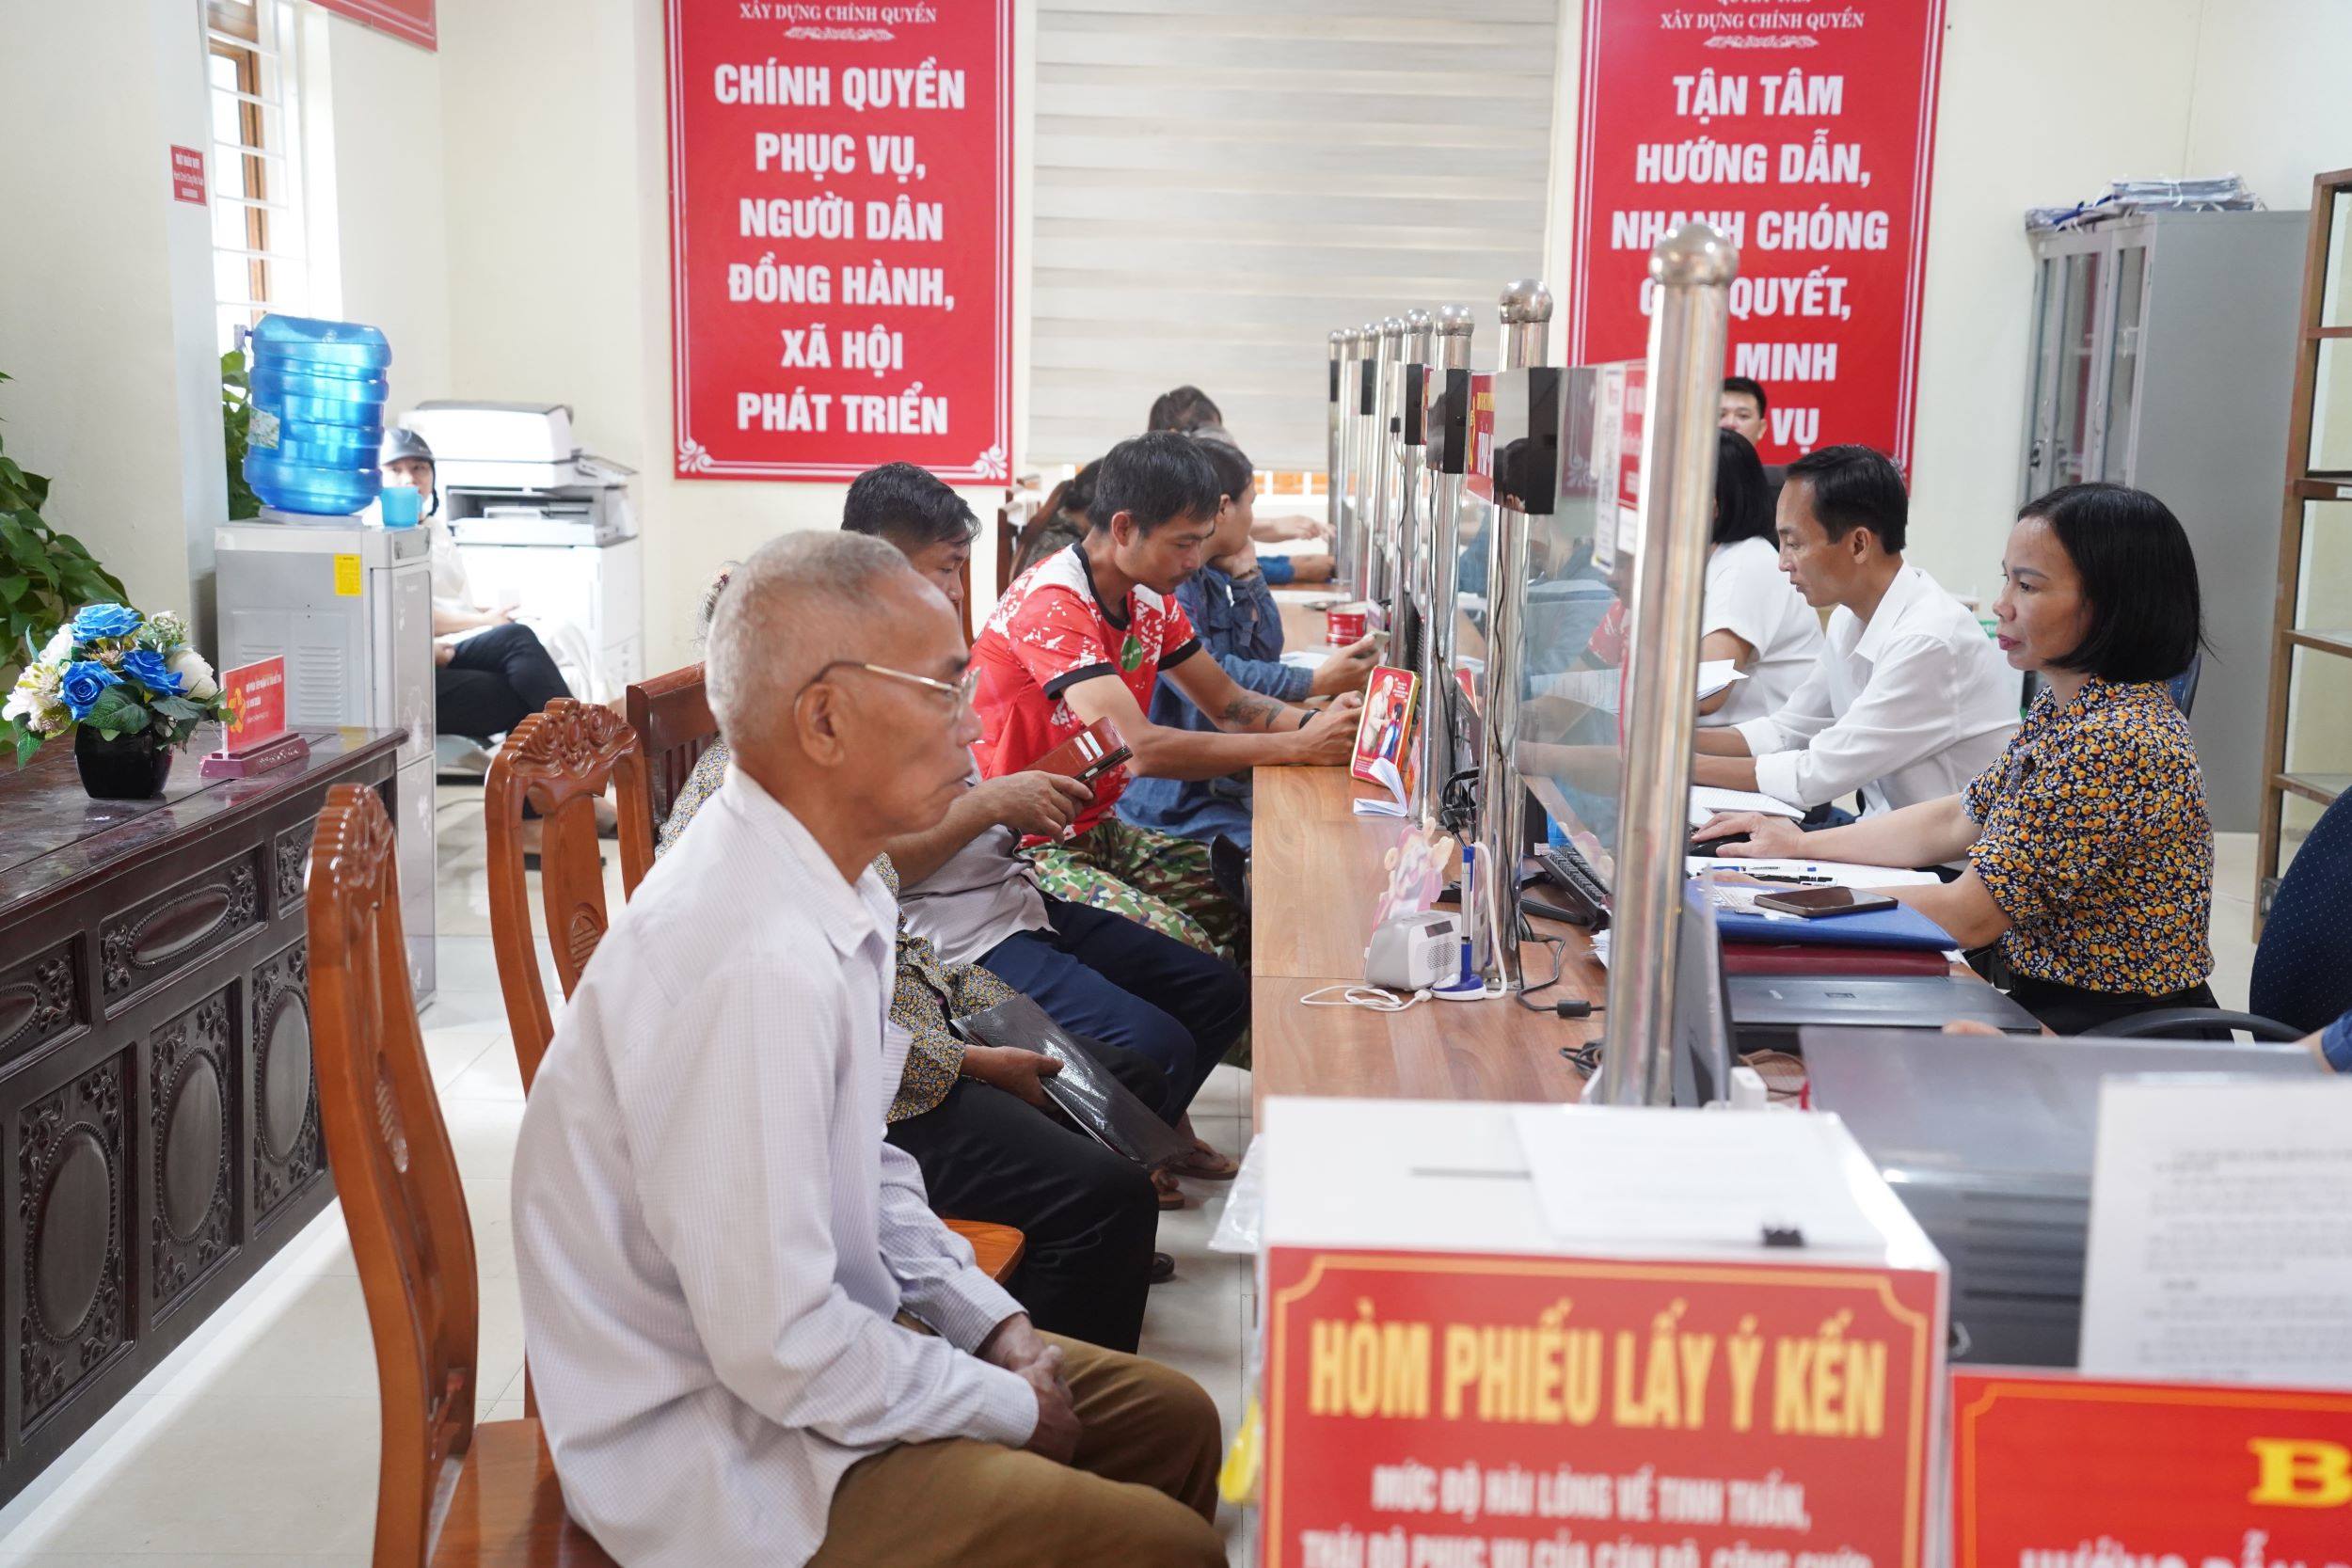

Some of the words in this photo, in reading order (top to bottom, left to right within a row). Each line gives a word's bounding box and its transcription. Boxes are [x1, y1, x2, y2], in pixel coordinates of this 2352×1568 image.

[775, 3, 820, 24] DỰNG
[825, 2, 877, 22] CHÍNH
[1661, 8, 1693, 29] XÂY
[1697, 13, 1744, 33] DỰNG
[1748, 9, 1803, 30] CHÍNH
[713, 56, 830, 106] CHÍNH
[842, 55, 965, 111] QUYỀN
[1673, 68, 1748, 124] TẬN
[1759, 68, 1844, 117] TÂM
[755, 132, 855, 182] PHỤC
[866, 135, 926, 183] VỤ,
[1635, 136, 1768, 184] HƯỚNG
[1779, 129, 1871, 188] DẪN,
[739, 191, 854, 240] NGƯỜI
[866, 194, 944, 242] DÂN
[1612, 210, 1746, 250] NHH
[1756, 203, 1890, 251] CHÓNG
[727, 251, 831, 304] ĐỒNG
[842, 258, 955, 311] HÀNH,
[1729, 265, 1851, 321] QUYẾT,
[780, 323, 832, 369] XÃ
[841, 324, 903, 378] HỘI
[1735, 342, 1837, 382] MINH
[737, 386, 832, 433] PHÁT
[841, 381, 948, 435] TRIỂN
[1771, 407, 1820, 454] VỤ
[1309, 1297, 1432, 1419] HÒM
[1442, 1297, 1604, 1425] PHIẾU
[1613, 1298, 1716, 1431] LẤY
[1726, 1313, 1764, 1433] Ý
